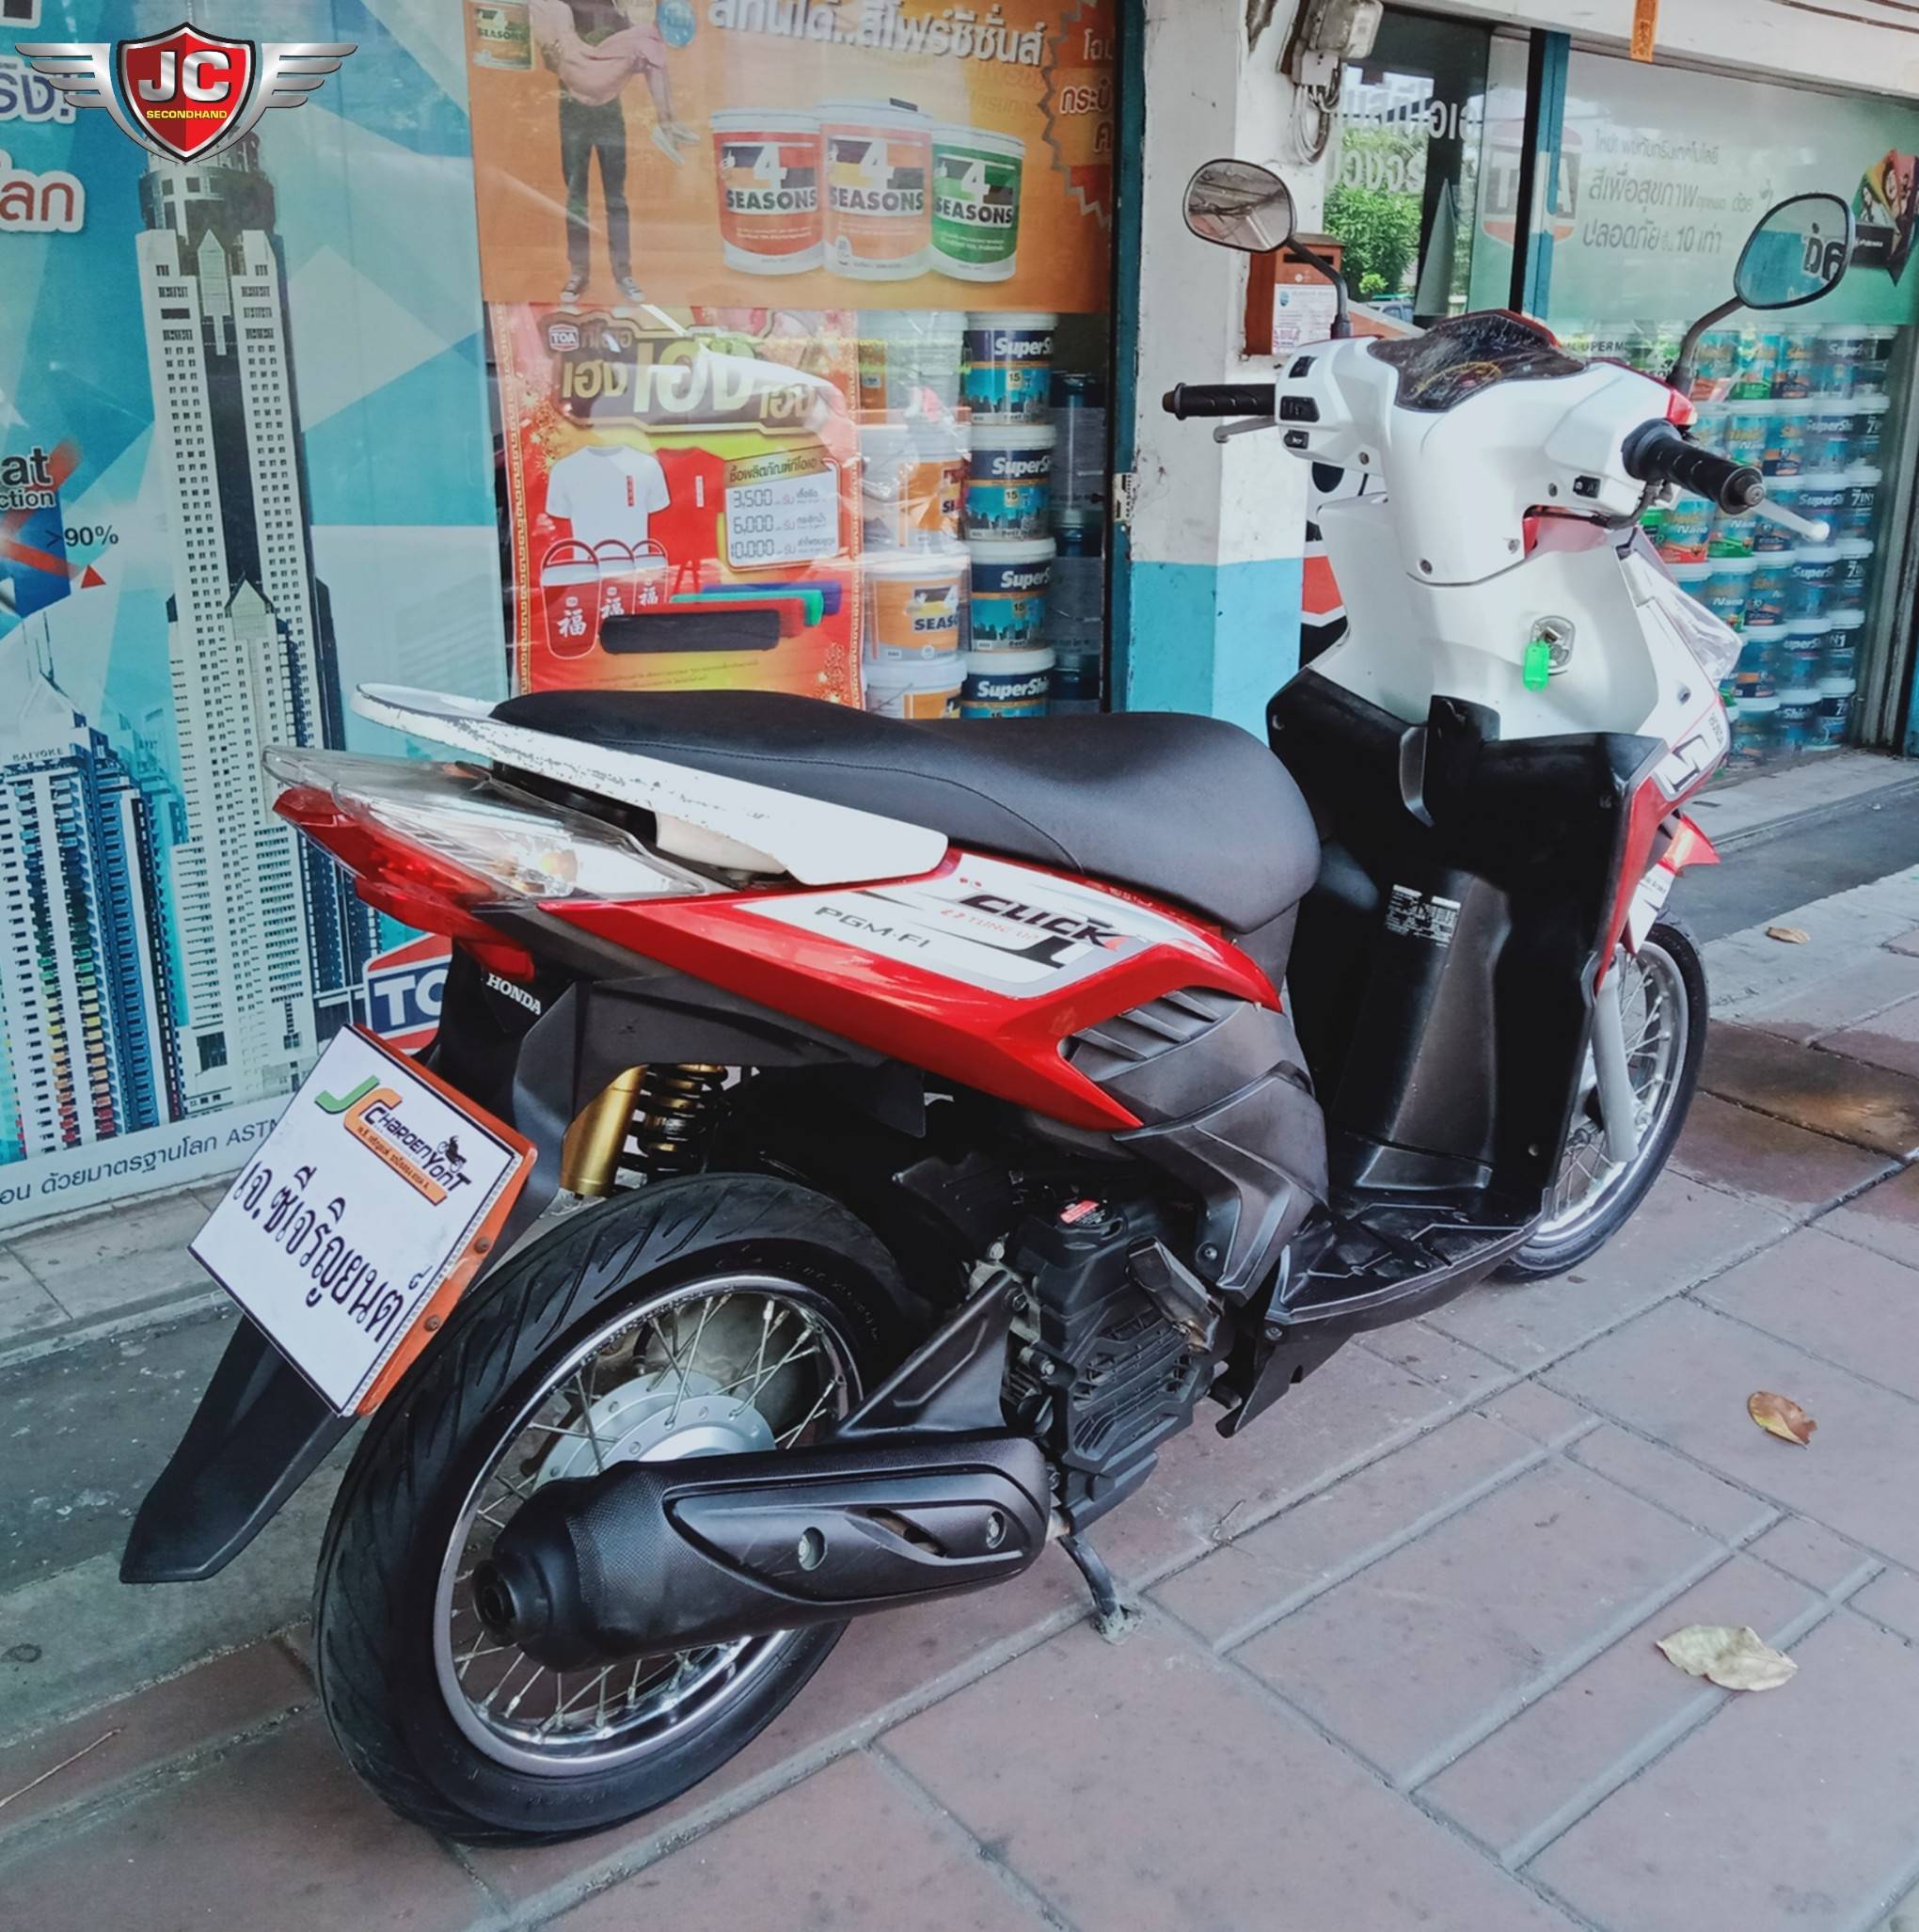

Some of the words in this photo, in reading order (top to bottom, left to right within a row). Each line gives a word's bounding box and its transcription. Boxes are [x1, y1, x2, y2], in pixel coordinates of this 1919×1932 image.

[753, 143, 788, 188] 4
[859, 140, 895, 189] 4
[961, 161, 991, 199] 4
[727, 189, 817, 210] SEASONS
[831, 187, 924, 211] SEASONS
[935, 195, 1013, 225] SEASONS
[1676, 225, 1695, 253] 10
[550, 332, 578, 344] TOA
[1009, 372, 1021, 383] 15
[1006, 490, 1018, 500] 15
[734, 515, 774, 534] 6,000
[638, 586, 659, 607] 福
[1014, 601, 1025, 611] 15
[557, 609, 587, 637] 福
[959, 894, 1110, 949] CLICK
[373, 969, 449, 1026] TO
[486, 973, 542, 1016] HONDA
